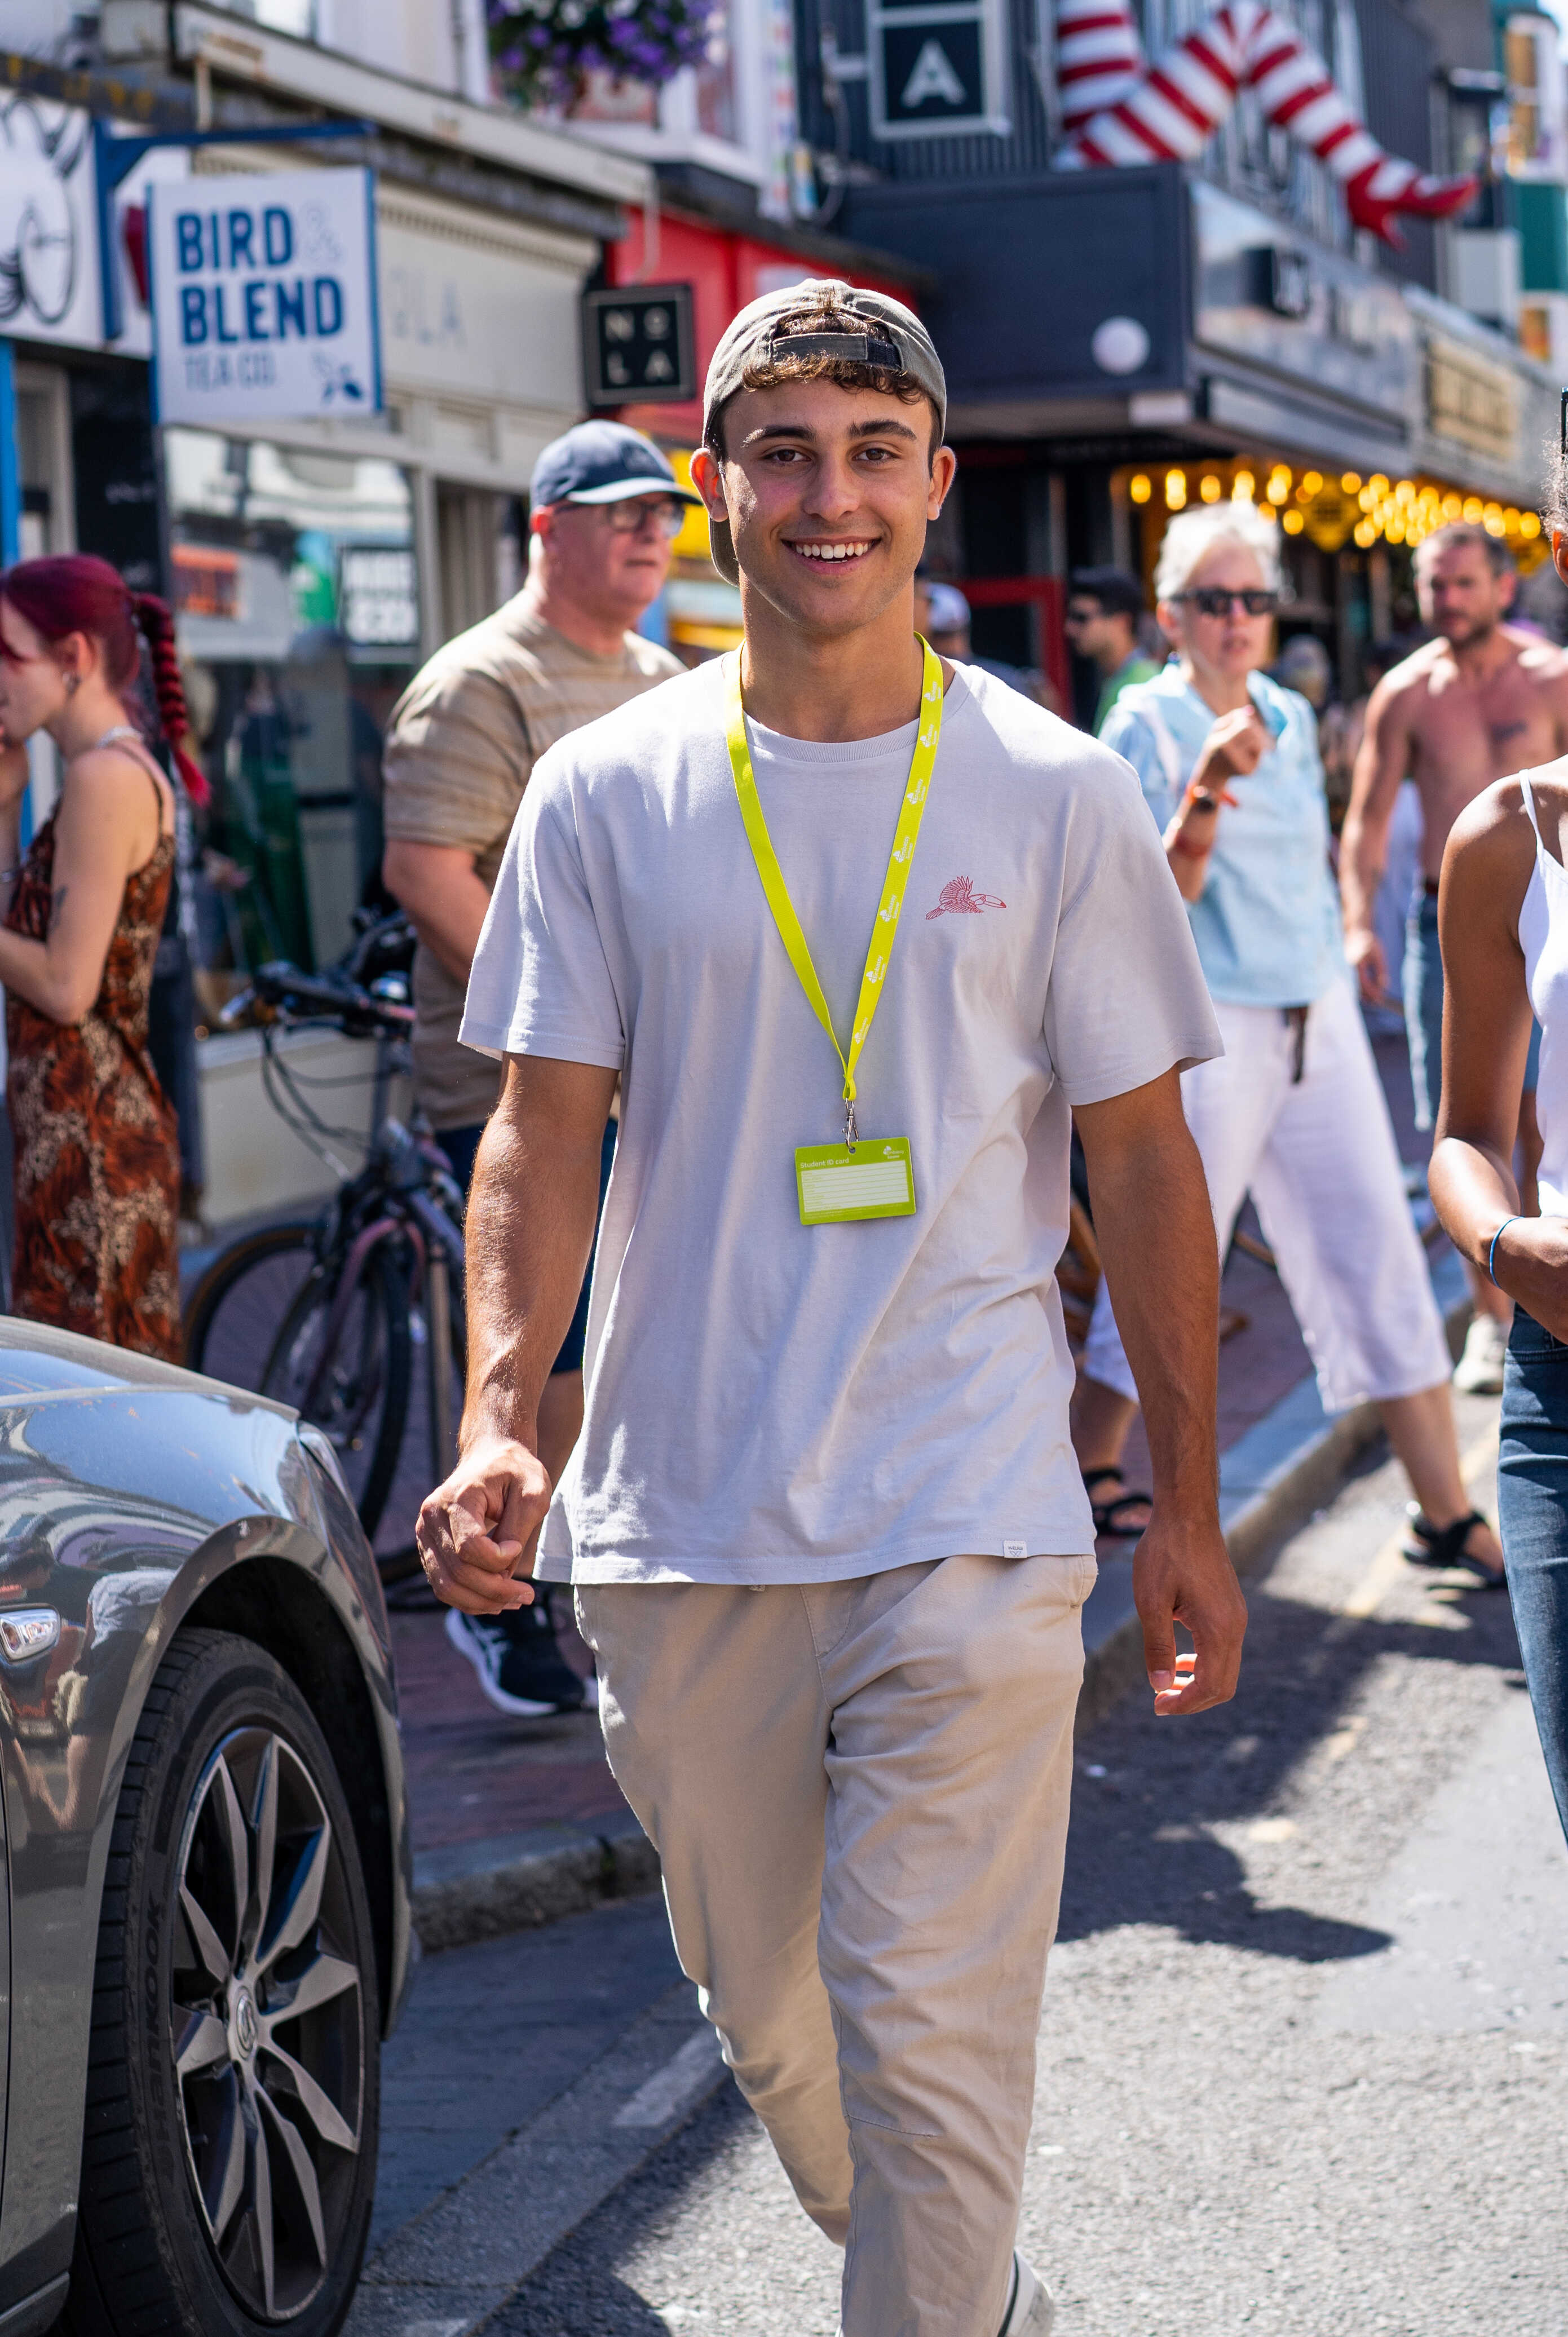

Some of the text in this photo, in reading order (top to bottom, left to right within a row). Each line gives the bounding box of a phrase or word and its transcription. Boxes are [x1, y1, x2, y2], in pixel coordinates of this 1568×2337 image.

[901, 38, 967, 109] A
[176, 204, 294, 272] BIRD
[181, 277, 343, 344] BLEND
[184, 354, 232, 391] TEA
[873, 955, 884, 979] Embassy
[800, 1160, 826, 1169] Student
